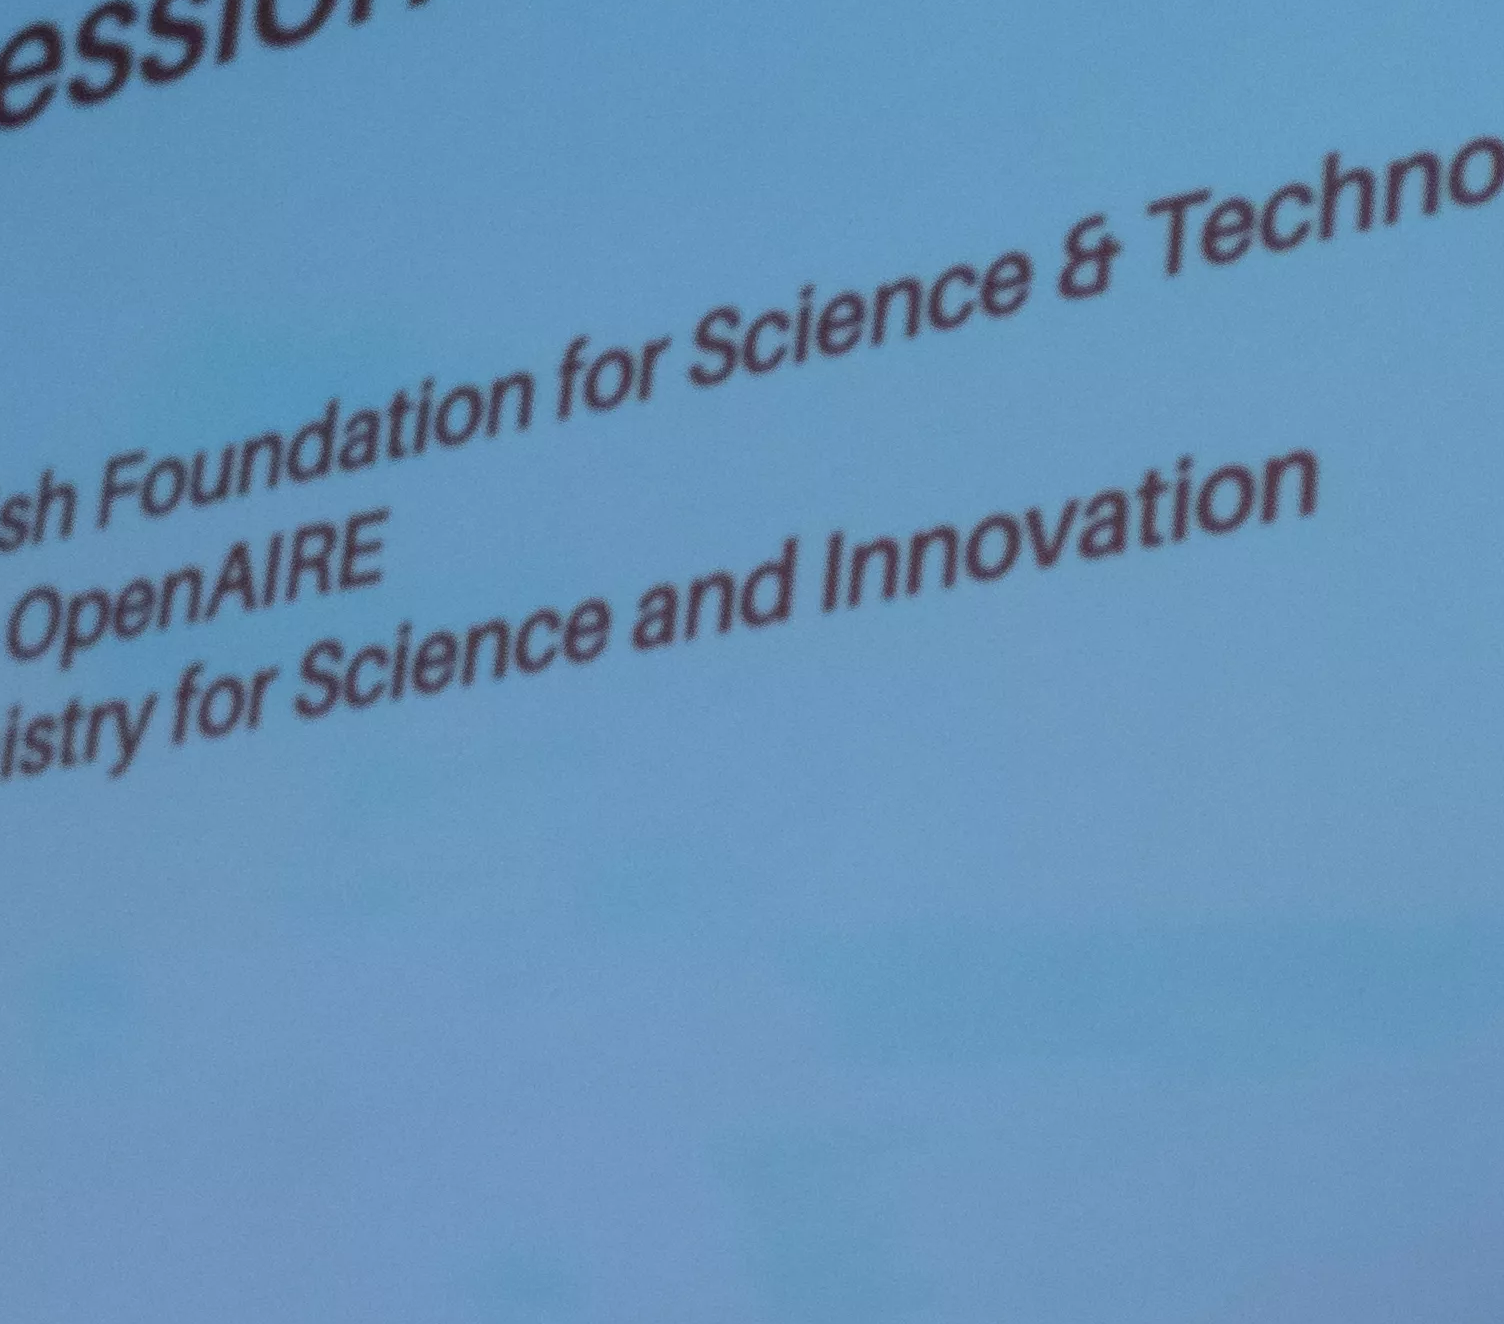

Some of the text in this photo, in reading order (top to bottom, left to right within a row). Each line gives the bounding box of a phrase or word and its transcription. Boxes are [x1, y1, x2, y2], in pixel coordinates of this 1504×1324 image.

[95, 369, 538, 531] Foundation
[554, 333, 673, 423] for
[685, 248, 1036, 391] Science
[1054, 212, 1124, 303] &
[0, 506, 394, 671] OpenAIRE
[169, 665, 282, 747] for
[291, 596, 615, 722] Science
[628, 534, 801, 654] and
[819, 447, 1321, 615] Innovation
